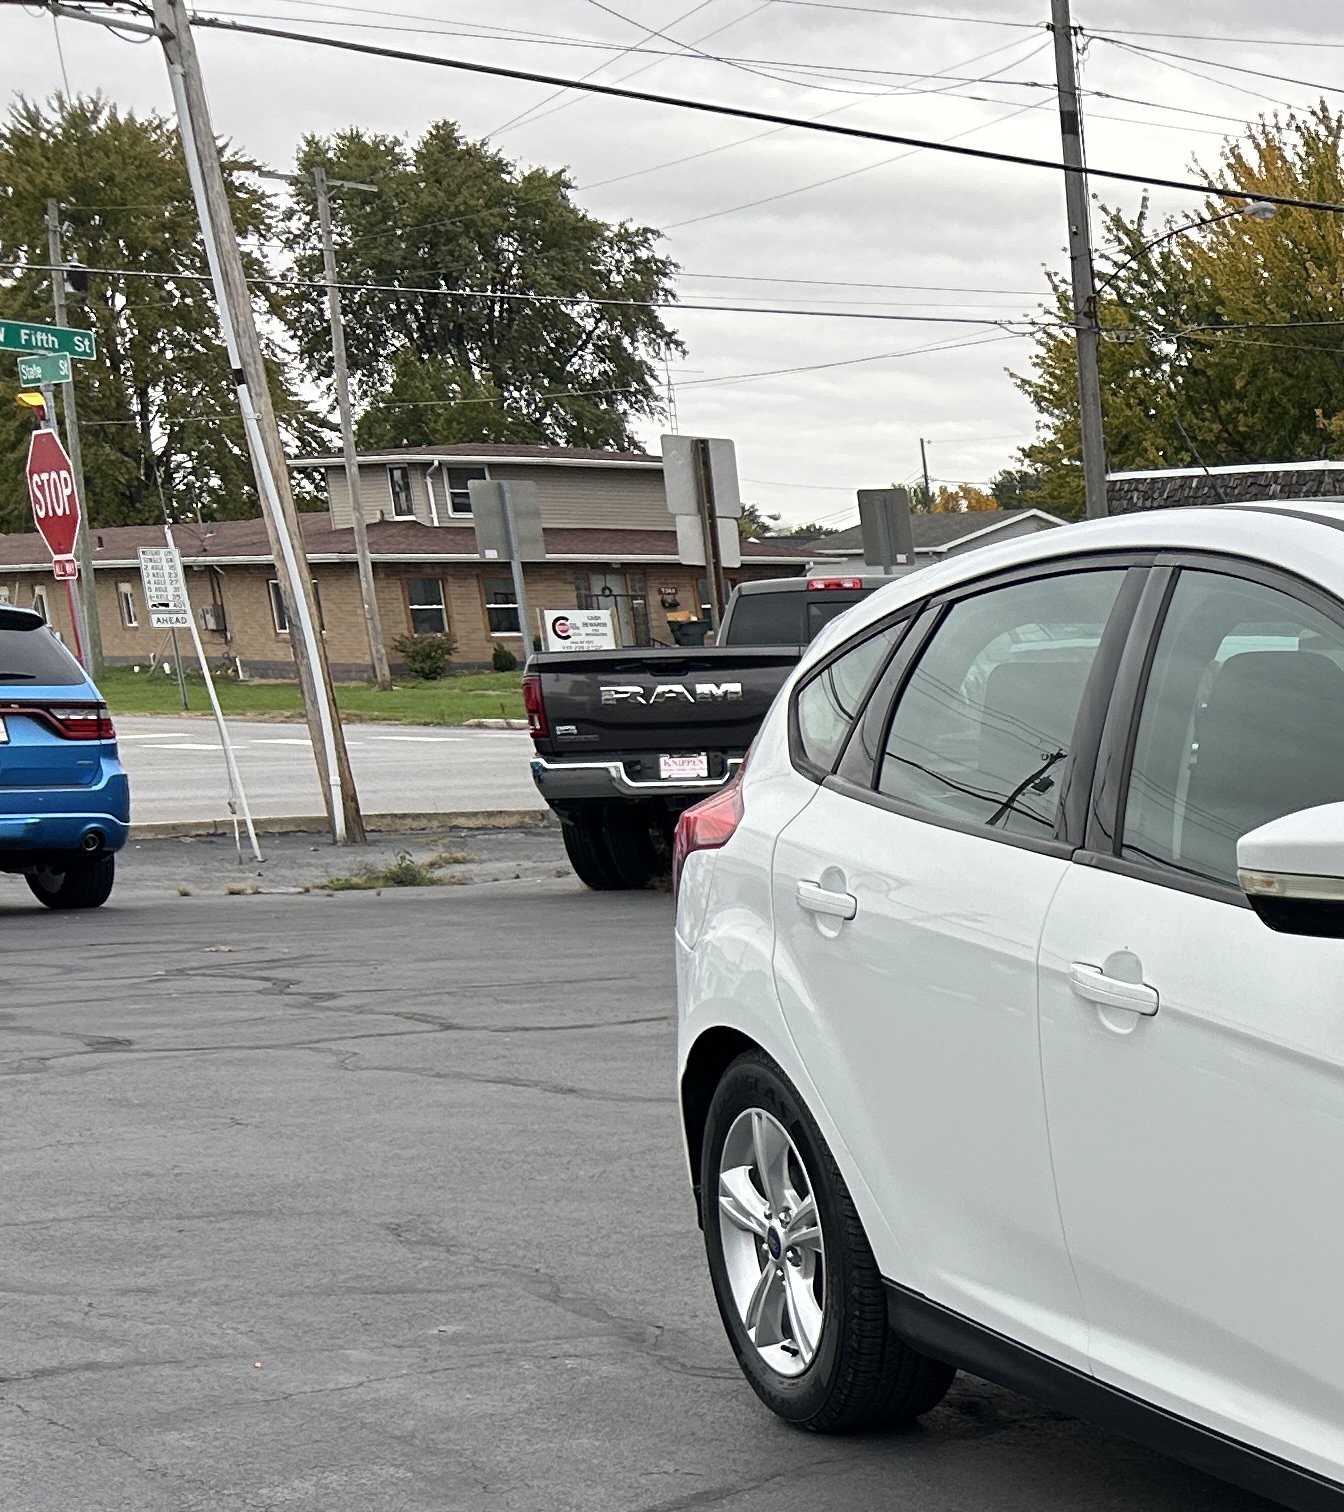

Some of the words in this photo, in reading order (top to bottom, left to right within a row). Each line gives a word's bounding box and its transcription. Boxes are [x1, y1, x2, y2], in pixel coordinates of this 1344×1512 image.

[20, 329, 59, 349] Fifth
[73, 336, 91, 353] St
[32, 470, 72, 519] STOP
[156, 616, 188, 625] AHEAD
[599, 682, 742, 705] RAM
